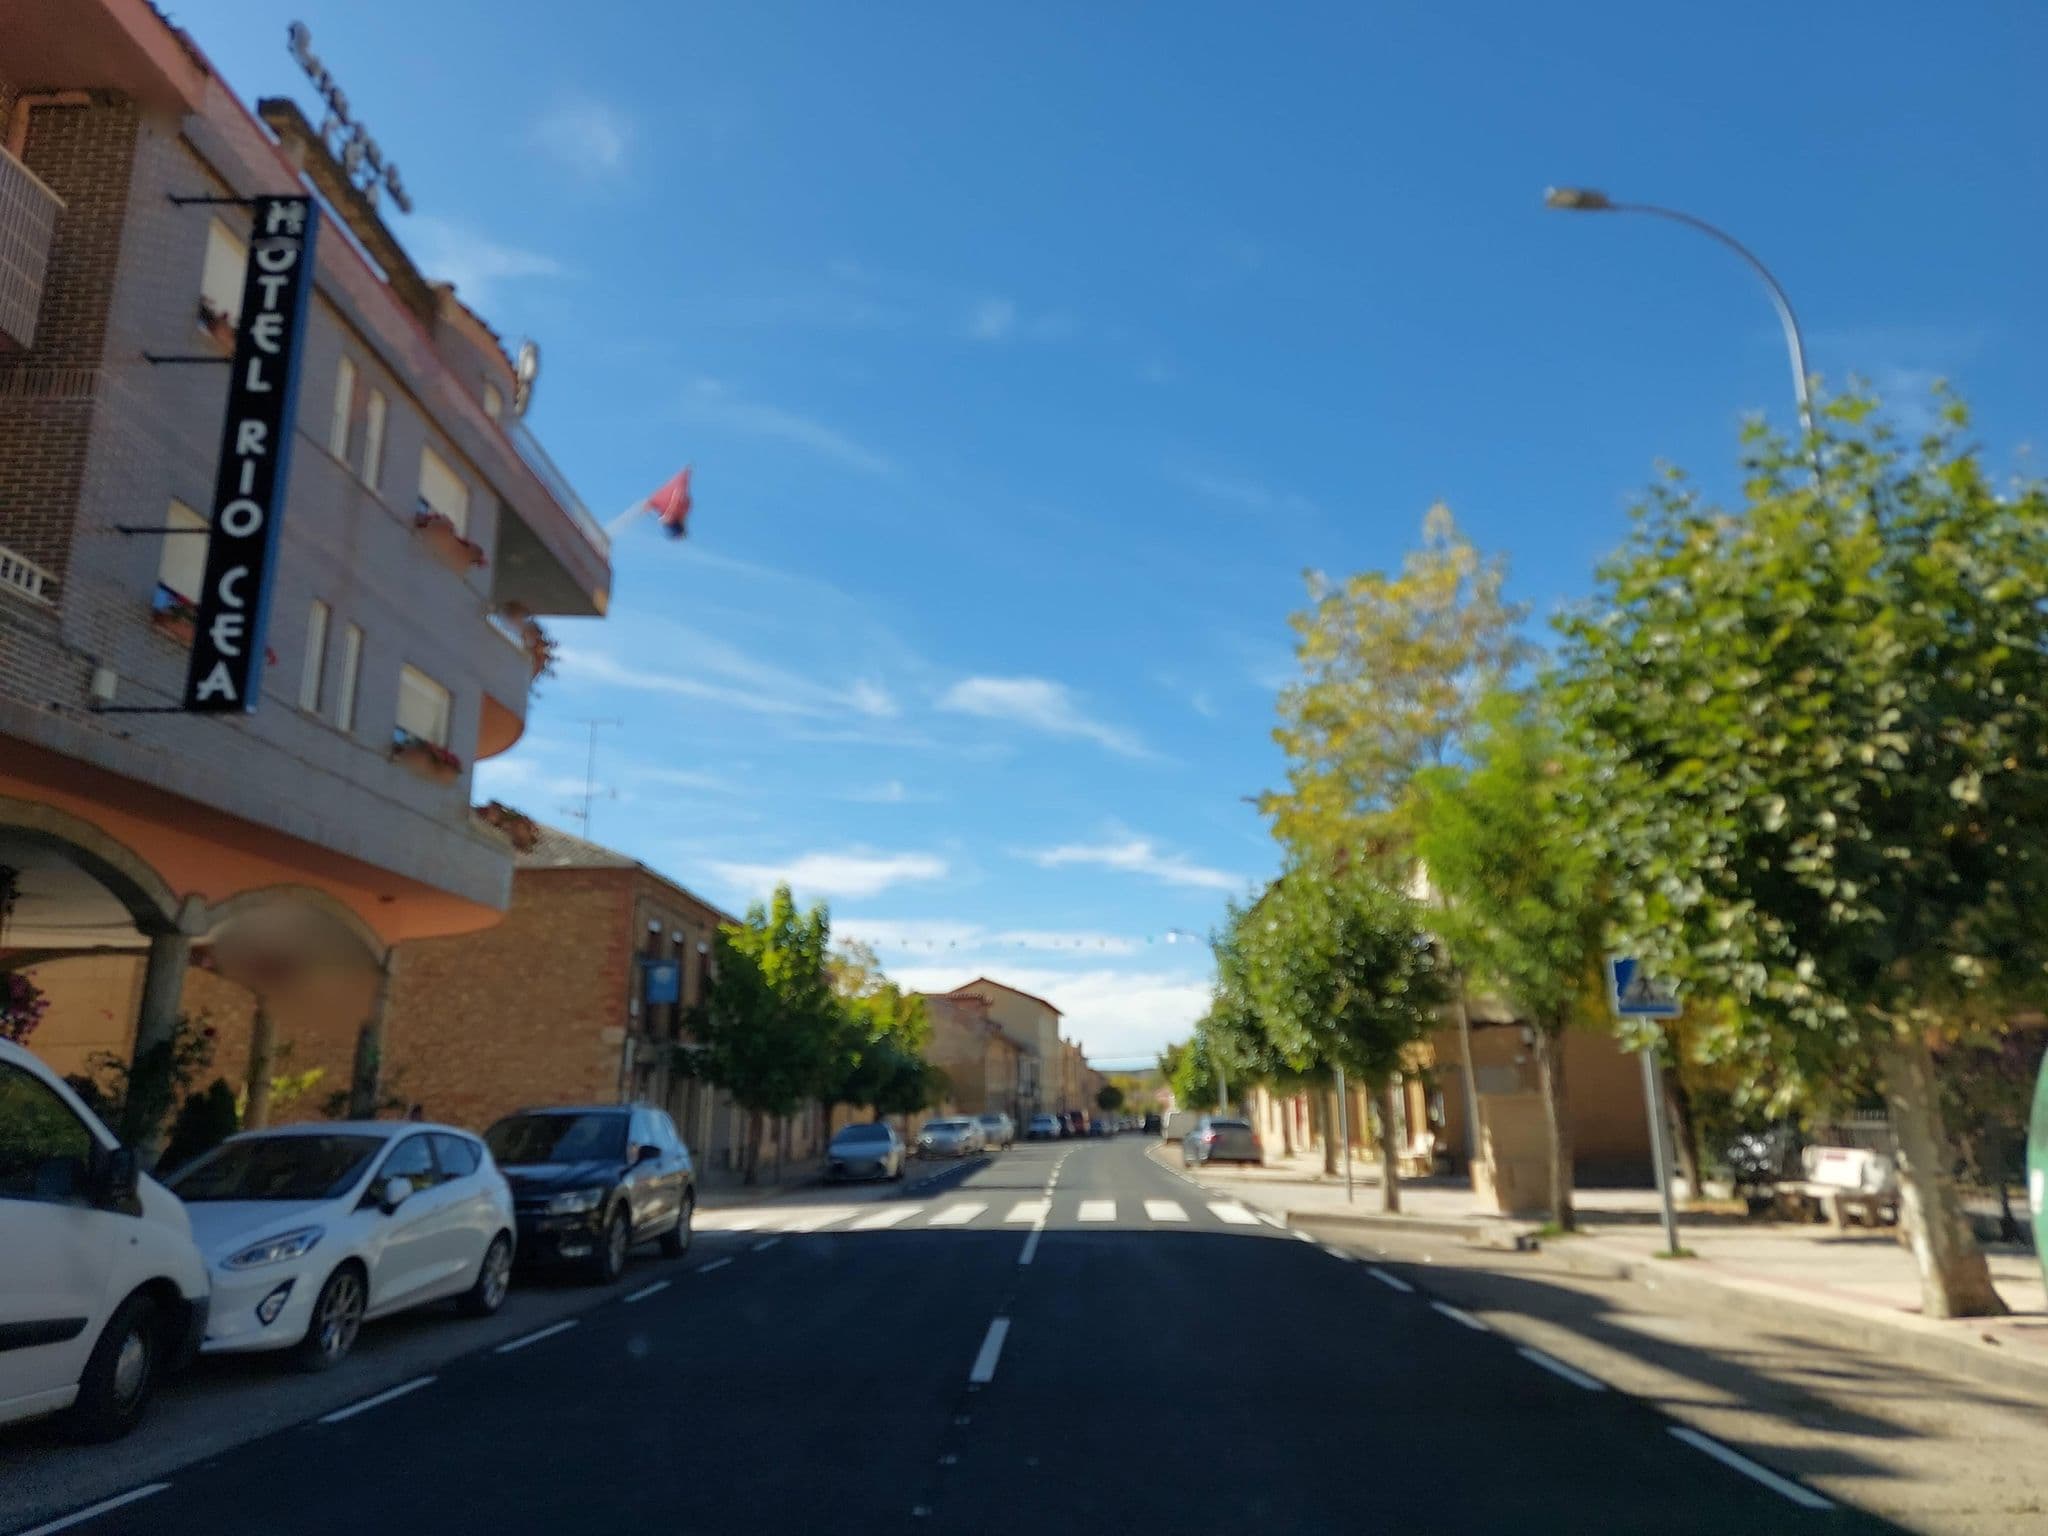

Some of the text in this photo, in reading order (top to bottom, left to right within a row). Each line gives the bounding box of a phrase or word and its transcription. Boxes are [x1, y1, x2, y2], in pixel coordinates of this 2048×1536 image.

[196, 200, 307, 701] HOTEL RIO CEA
